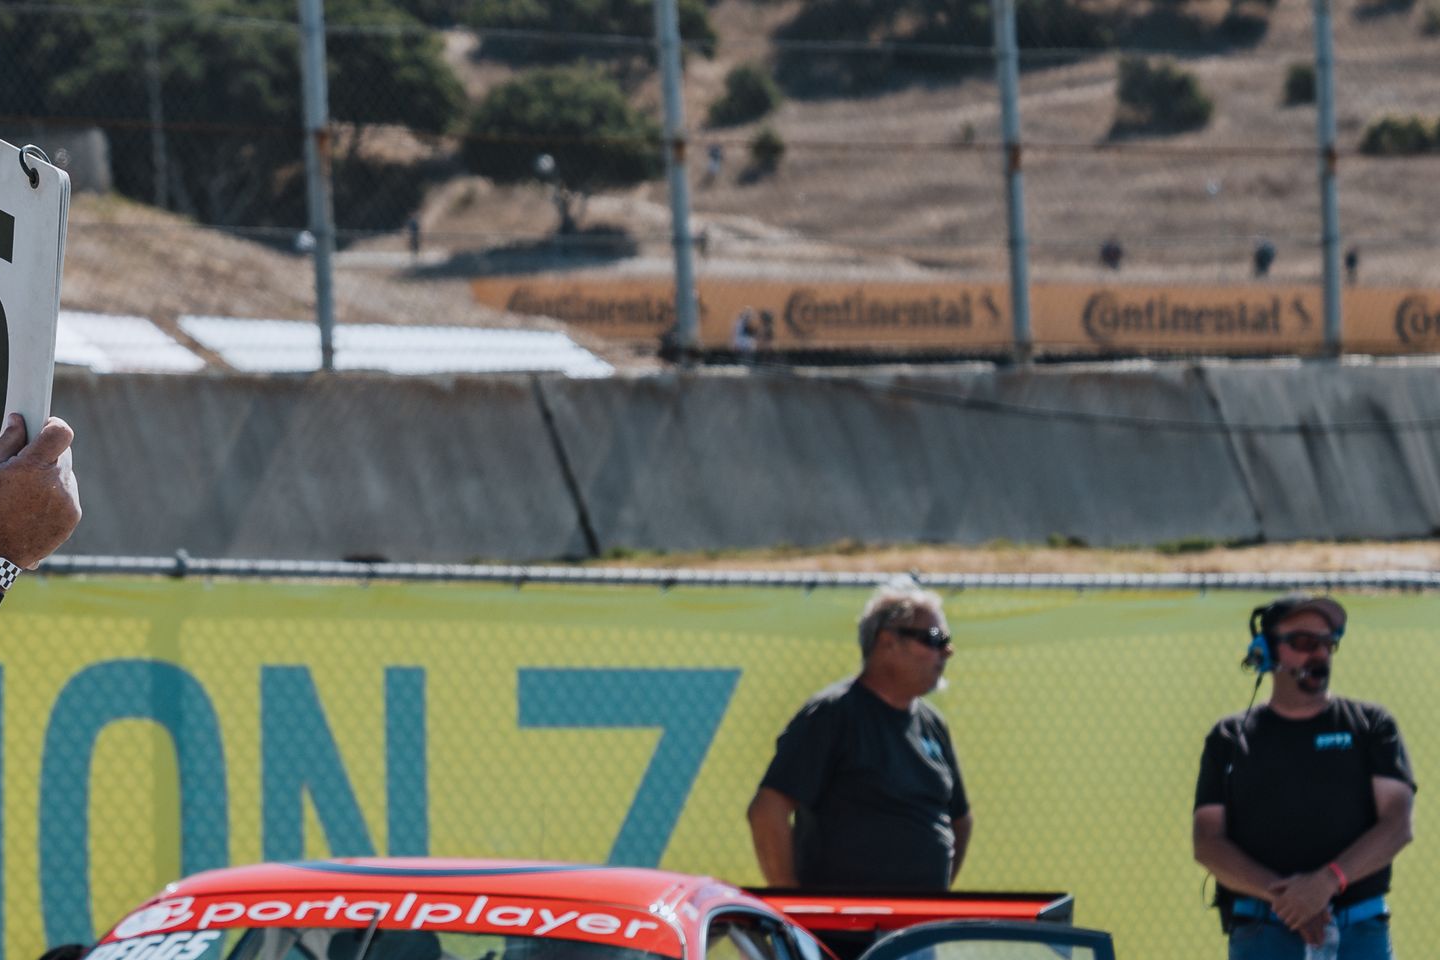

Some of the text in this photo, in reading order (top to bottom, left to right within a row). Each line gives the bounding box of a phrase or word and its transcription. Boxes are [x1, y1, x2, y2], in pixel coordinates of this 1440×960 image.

[784, 289, 971, 338] Continental
[1082, 292, 1281, 342] Continental
[517, 666, 744, 868] 7
[197, 892, 659, 939] portalplayer
